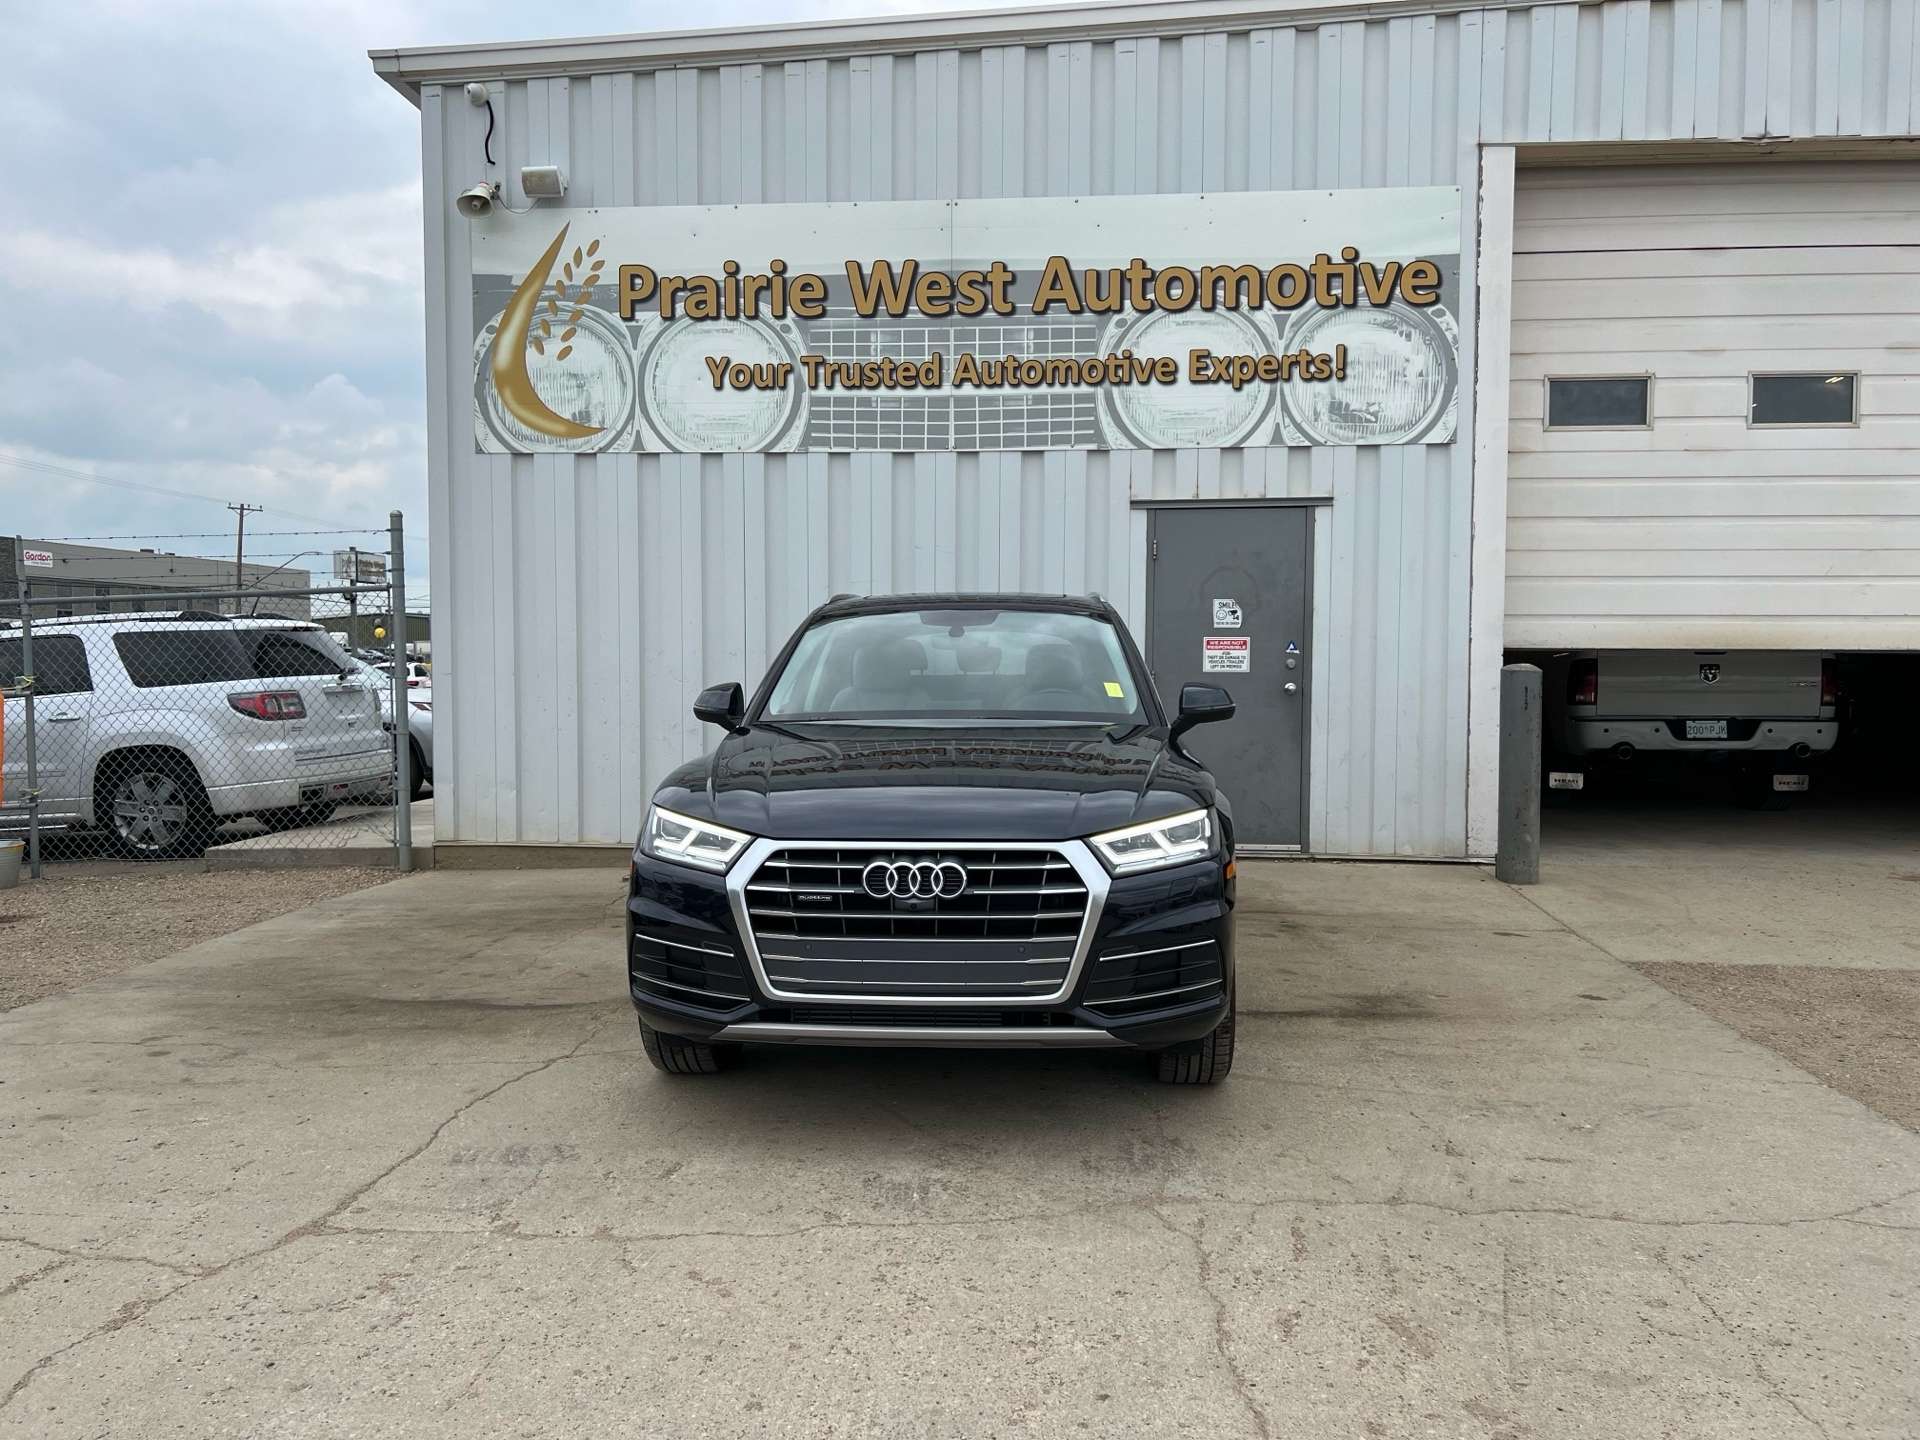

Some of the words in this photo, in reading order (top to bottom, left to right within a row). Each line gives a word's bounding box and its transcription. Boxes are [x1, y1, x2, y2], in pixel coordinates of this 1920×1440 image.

[617, 258, 826, 320] Prairie
[845, 257, 1015, 319] West
[1031, 246, 1440, 313] Automotive
[705, 355, 791, 388] Your
[800, 352, 942, 389] Trusted
[952, 348, 1175, 388] Automotive
[1188, 343, 1348, 390] Experts!
